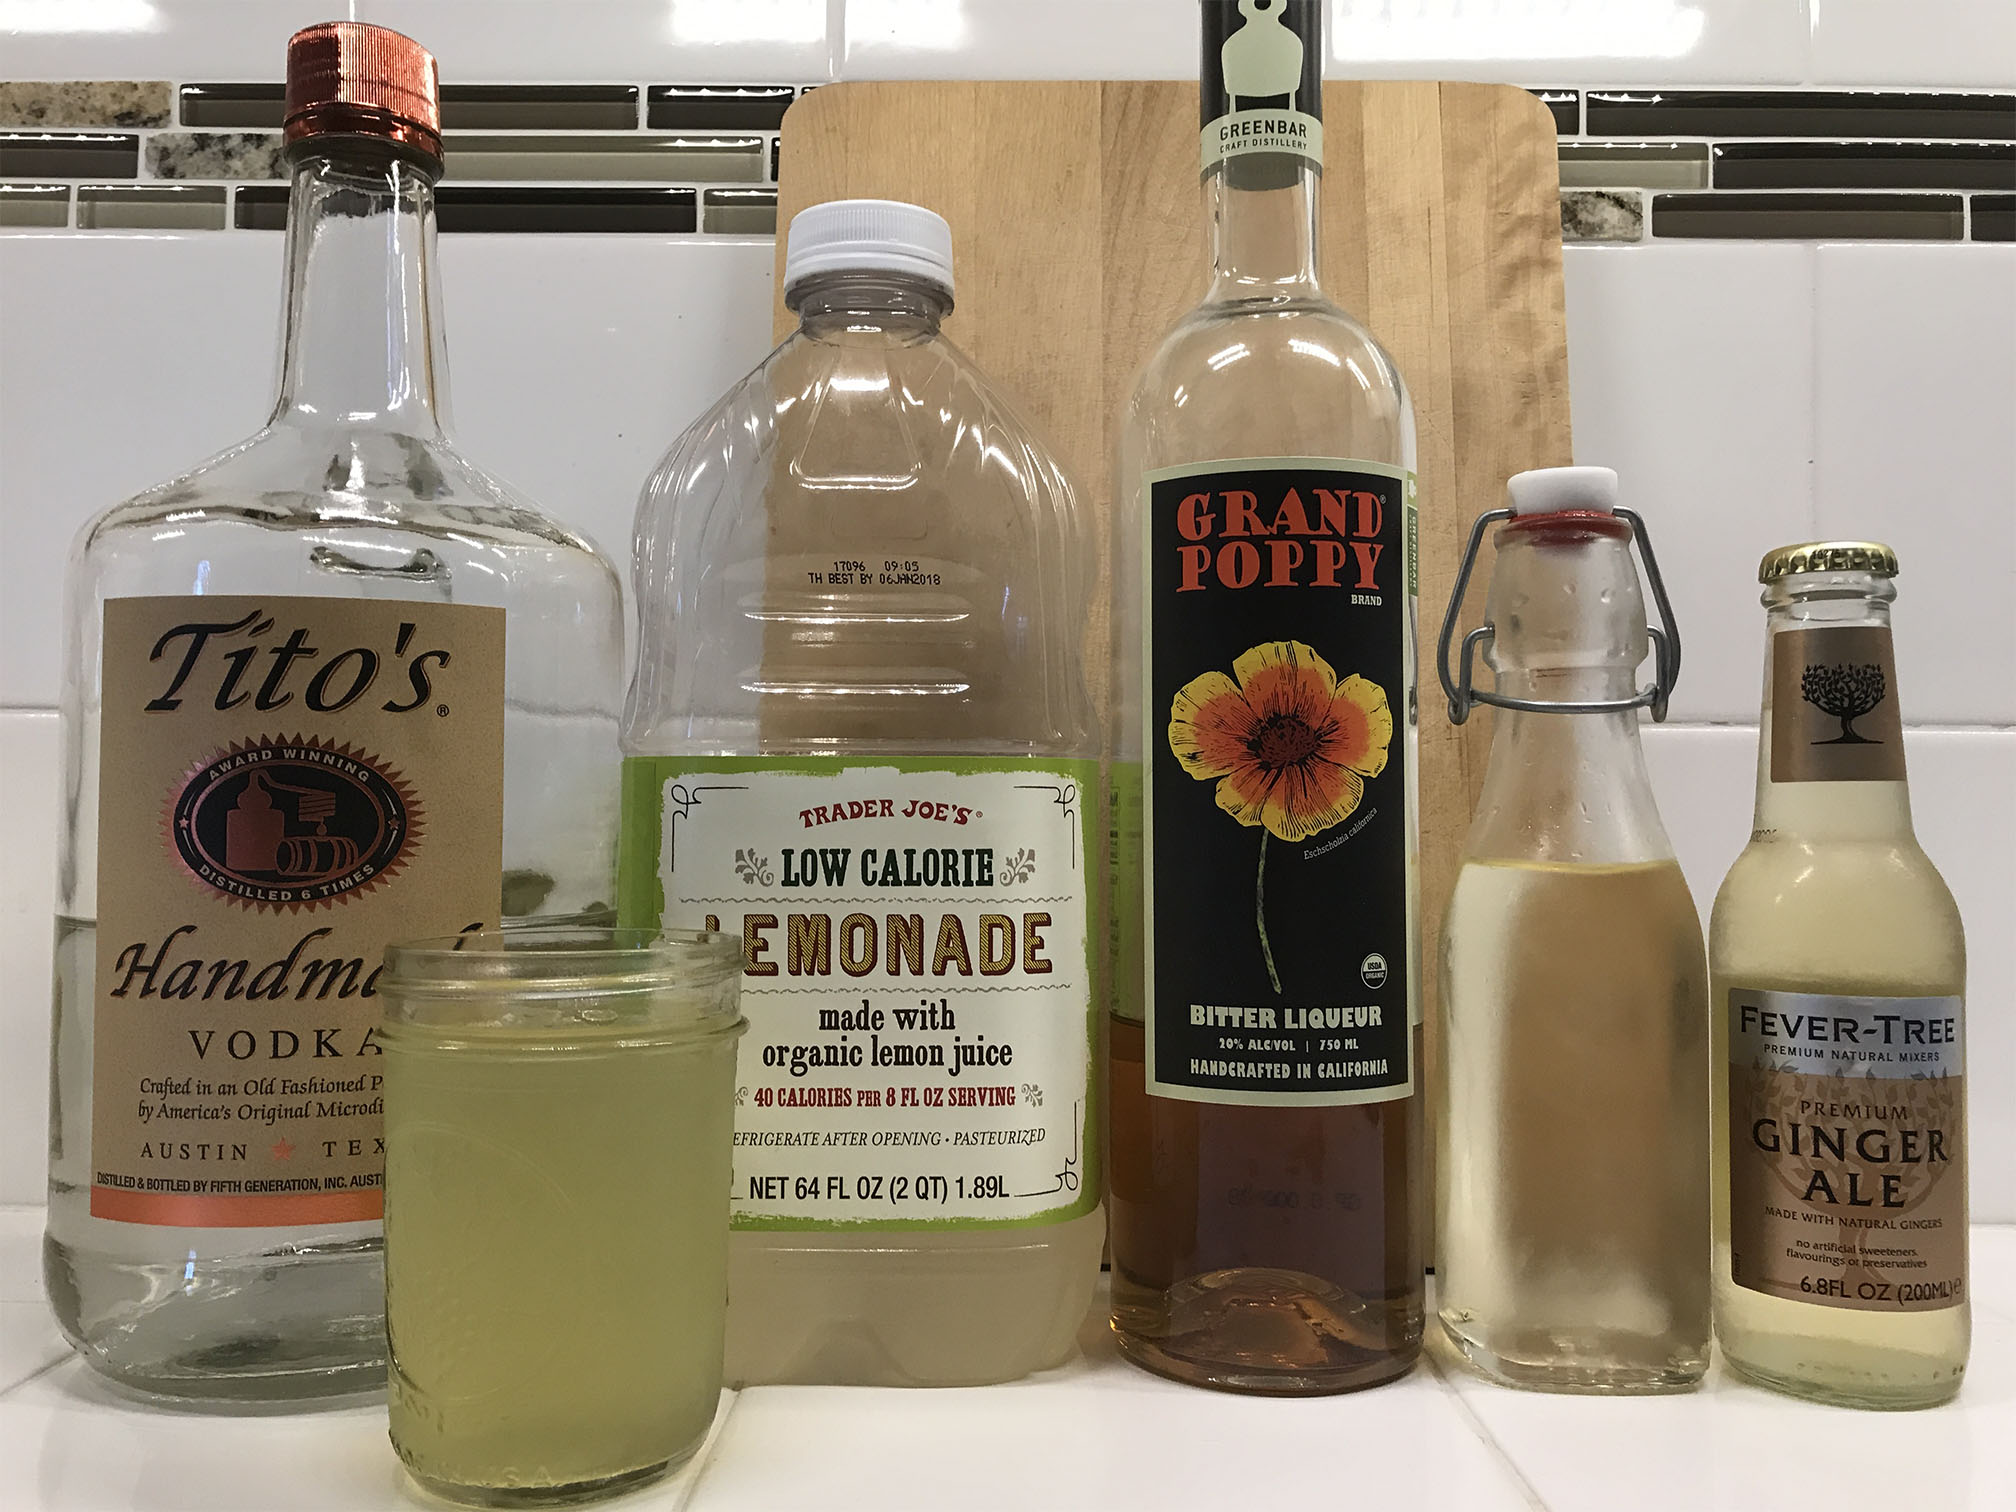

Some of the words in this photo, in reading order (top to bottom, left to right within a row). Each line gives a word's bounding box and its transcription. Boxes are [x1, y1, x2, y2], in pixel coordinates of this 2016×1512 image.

[1220, 119, 1307, 141] GREENBAR
[1220, 139, 1248, 153] CRAFT
[1252, 138, 1307, 150] DISTILLERY
[1176, 487, 1383, 541] GRAND
[808, 572, 823, 584] TH
[828, 572, 854, 584] BEST
[860, 573, 873, 585] BY
[879, 573, 941, 585] 06JAN2018
[833, 560, 866, 572] 17096
[884, 560, 919, 572] 09:05
[1175, 540, 1384, 592] POPPY
[1351, 594, 1382, 606] BRAND
[144, 608, 452, 713] Tito's
[208, 749, 273, 782] AWARD
[283, 749, 371, 783] WINNING
[799, 799, 895, 829] TRADER
[901, 799, 973, 826] JOE'S
[780, 847, 852, 888] LOW
[860, 847, 994, 888] CALORIE
[198, 863, 292, 901] DISTILLED
[301, 889, 311, 900] 6
[319, 864, 376, 897] TIMES
[818, 999, 885, 1032] made
[892, 998, 956, 1031] with
[1190, 1004, 1277, 1030] BITTER
[1284, 1005, 1382, 1030] LIQUEUR
[1740, 1004, 1955, 1045] FEVER-TREE
[188, 1027, 383, 1060] VODKA
[762, 1035, 863, 1077] organic
[870, 1035, 945, 1068] lemon
[948, 1034, 1013, 1077] juice
[1218, 1038, 1243, 1050] 20%
[1248, 1039, 1296, 1051] ALC/VOL
[1319, 1038, 1341, 1051] 750
[1344, 1038, 1359, 1050] ML
[1764, 1043, 1824, 1059] PREMIUM
[1831, 1049, 1893, 1062] NATURAL
[1899, 1051, 1940, 1062] MIXERS
[1190, 1059, 1291, 1079] HANDCRAFTED
[1296, 1063, 1311, 1079] IN
[1317, 1059, 1388, 1078] CALIFORNIA
[140, 1076, 191, 1100] Crafted
[197, 1079, 211, 1095] in
[218, 1083, 237, 1096] an
[244, 1077, 275, 1096] Old
[281, 1074, 365, 1096] Fashioned
[753, 1087, 774, 1107] 40
[777, 1087, 853, 1108] CALORIES
[856, 1090, 881, 1108] PER
[885, 1087, 897, 1107] 8
[900, 1087, 920, 1107] FL
[923, 1087, 944, 1107] OZ
[947, 1086, 1016, 1107] SERVING
[138, 1100, 154, 1124] by
[156, 1102, 231, 1120] America's
[237, 1100, 311, 1126] Original
[316, 1097, 385, 1118] Microdi
[1800, 1100, 1909, 1121] PREMIUM
[140, 1142, 248, 1161] AUSTIN
[322, 1137, 386, 1157] TEX
[733, 1132, 820, 1147] EFRIGERATE
[822, 1132, 870, 1147] AFTER
[871, 1132, 942, 1146] OPENING
[952, 1128, 1046, 1147] PASTEURIZED
[1752, 1118, 1948, 1164] GINGER
[97, 1171, 136, 1189] DISTILLED
[137, 1179, 145, 1189] &
[146, 1179, 190, 1192] BOTTLED
[193, 1180, 209, 1193] BY
[210, 1180, 241, 1193] FIFTH
[244, 1178, 321, 1192] GENERATION,
[324, 1176, 348, 1189] INC.
[350, 1172, 384, 1187] AUSTI
[750, 1177, 789, 1201] NET
[794, 1177, 820, 1200] 64
[826, 1177, 850, 1200] FL
[857, 1176, 883, 1200] OZ
[889, 1175, 909, 1204] (2
[915, 1175, 949, 1204] QT)
[955, 1175, 1010, 1199] 1.89L
[1801, 1169, 1906, 1209] ALE
[1765, 1206, 1798, 1221] MADE
[1801, 1212, 1834, 1226] WITH
[1838, 1216, 1897, 1230] NATURAL
[1900, 1218, 1943, 1230] GINGERS
[1786, 1248, 1846, 1266] flavourings
[1862, 1258, 1928, 1269] preservatives
[1796, 1239, 1810, 1249] no
[1812, 1241, 1856, 1255] artificial
[1800, 1275, 1851, 1298] 6.8FL
[1858, 1282, 1891, 1301] OZ
[1897, 1279, 1953, 1305] (200ML)
